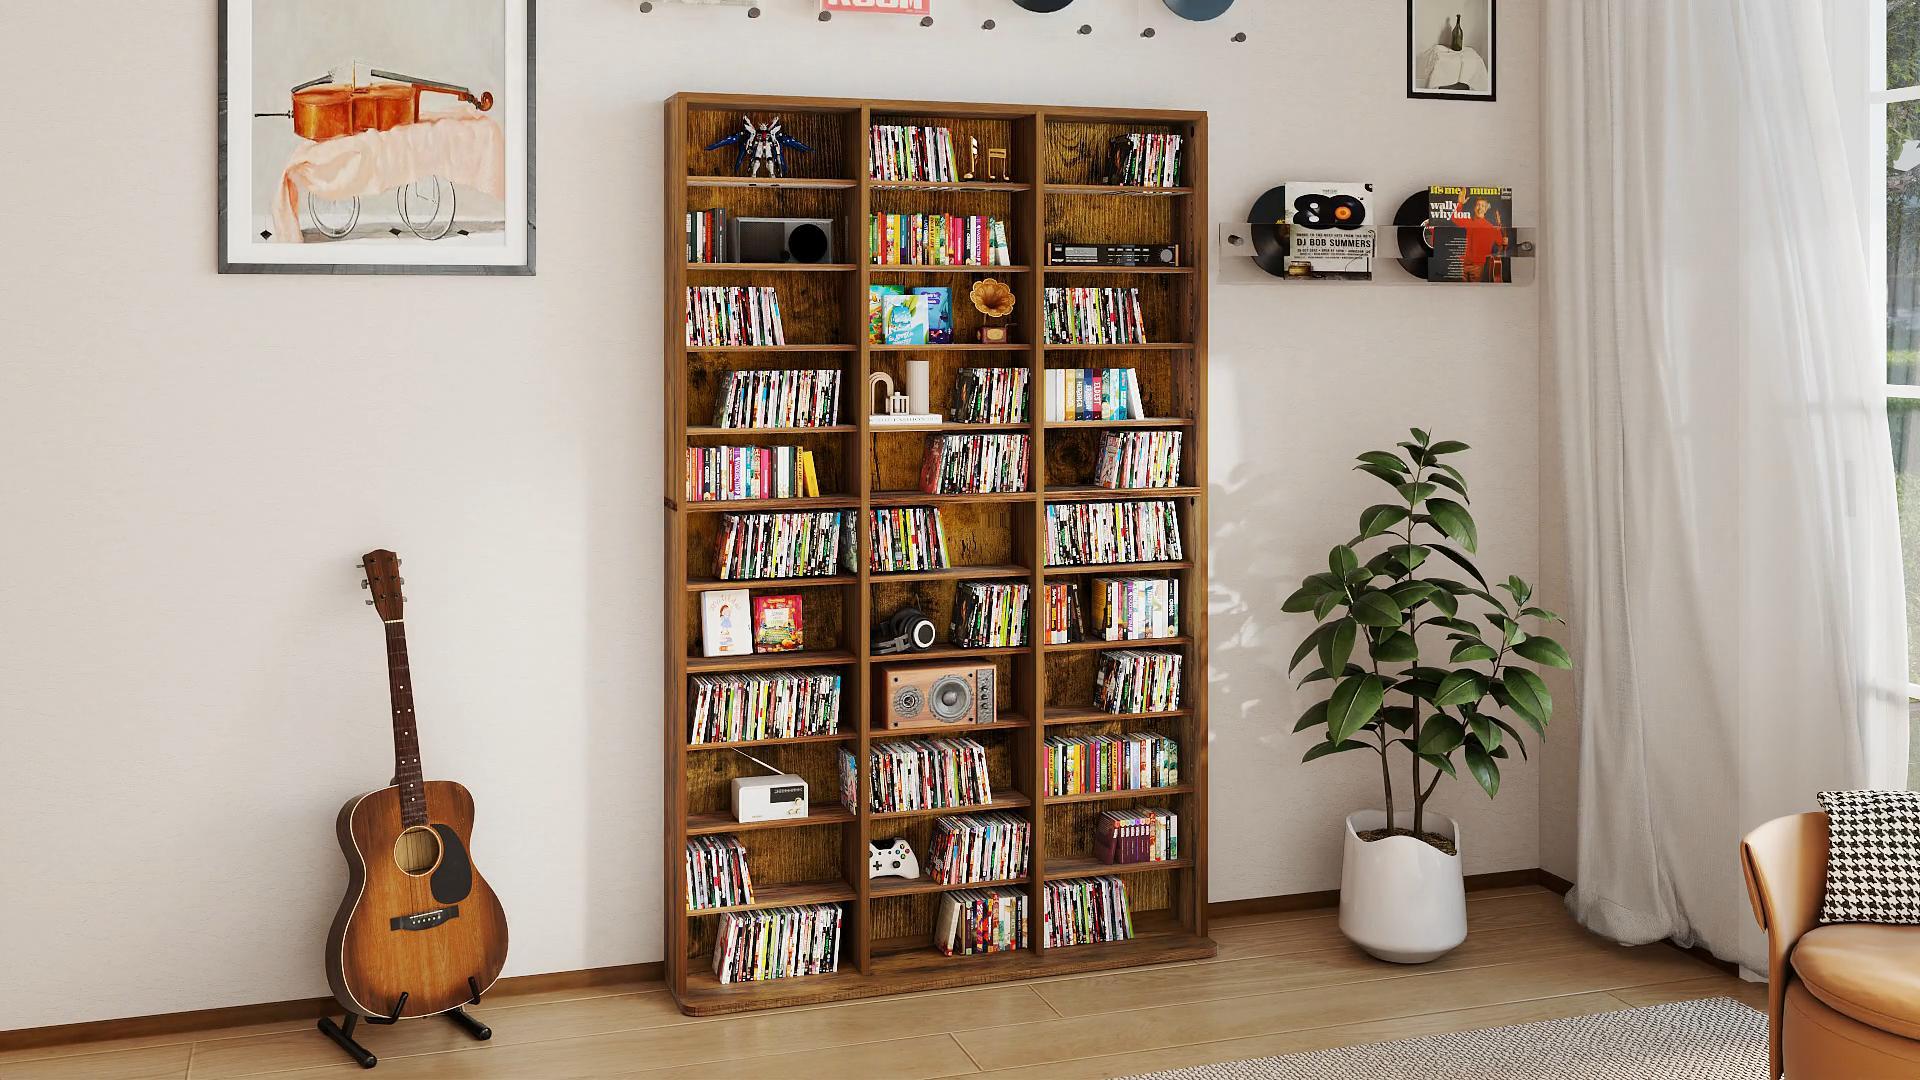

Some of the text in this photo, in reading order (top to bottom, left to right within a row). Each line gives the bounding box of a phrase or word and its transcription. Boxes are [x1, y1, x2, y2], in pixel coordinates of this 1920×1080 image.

[1469, 185, 1501, 196] mum!
[1429, 200, 1459, 213] wally
[1429, 209, 1471, 221] whyton
[1310, 238, 1326, 246] BOB
[1330, 238, 1370, 248] SUMMERS
[1094, 382, 1102, 405] ELDEST
